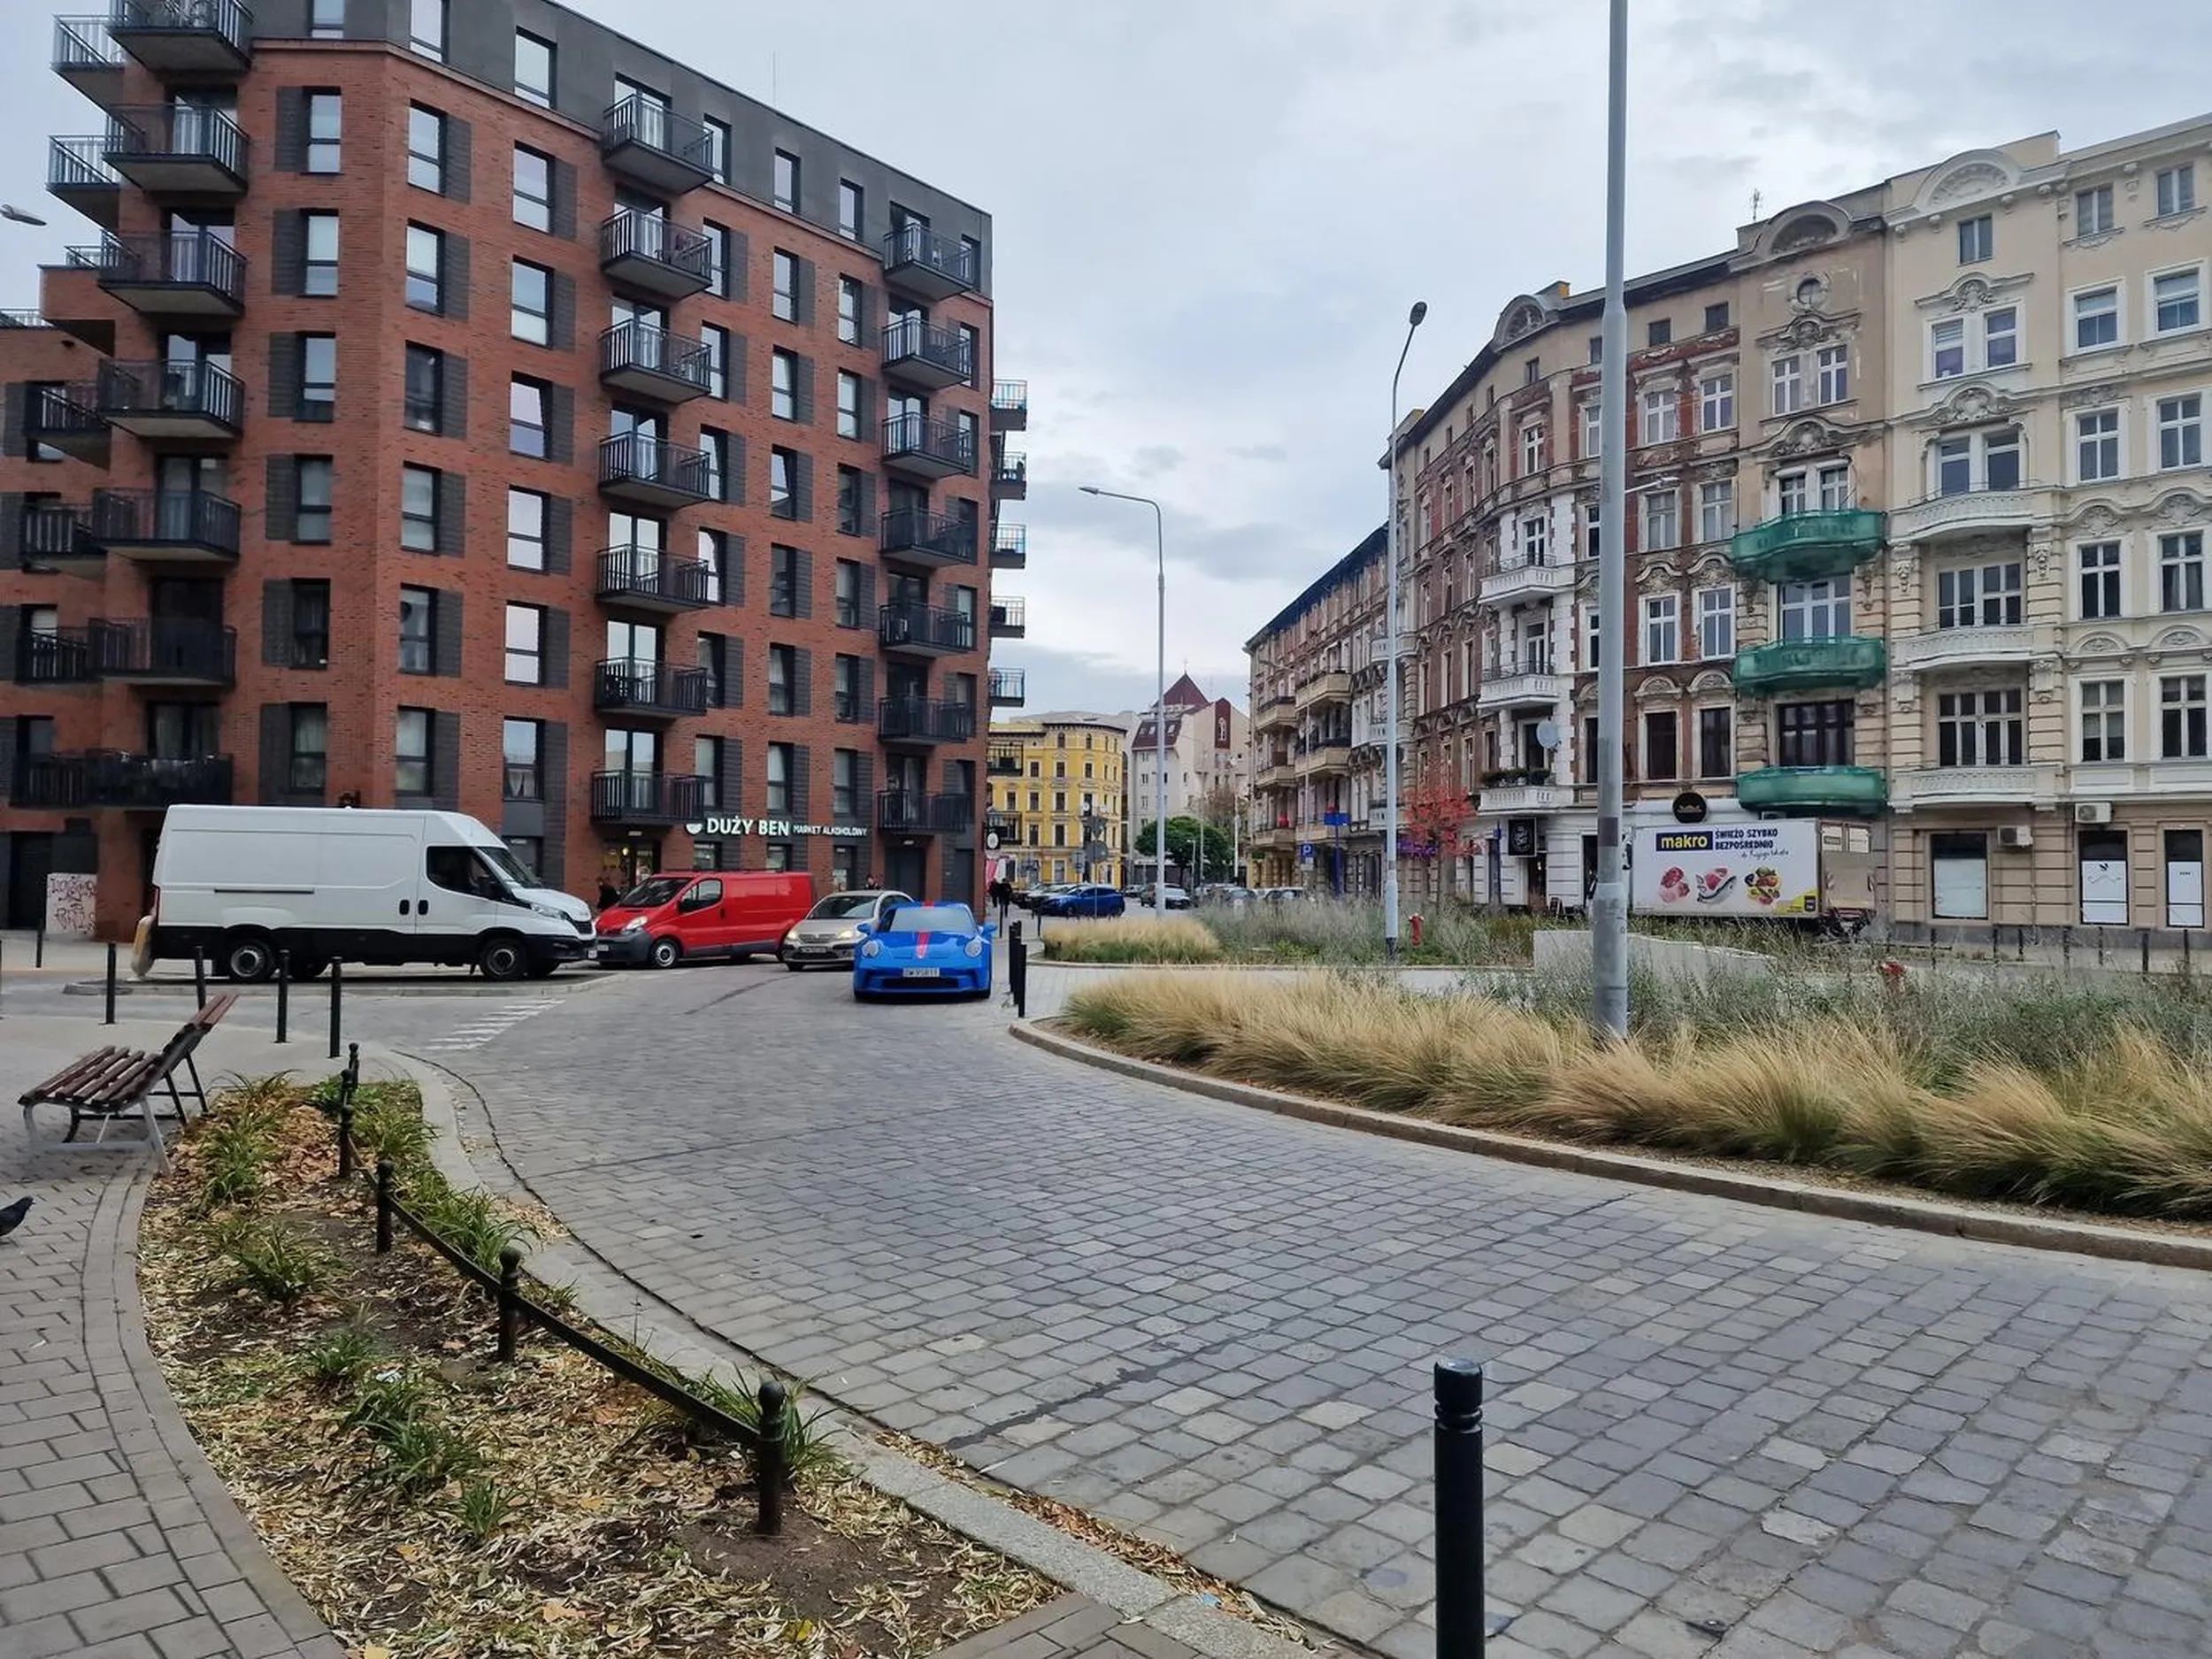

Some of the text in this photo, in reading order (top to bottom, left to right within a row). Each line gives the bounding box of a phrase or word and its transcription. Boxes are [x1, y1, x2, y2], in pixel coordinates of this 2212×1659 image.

[707, 815, 867, 836] DUŻY BEN MARKET ALKOHOLOWY
[1747, 829, 1778, 838] SZYBKO
[1661, 834, 1708, 849] makro
